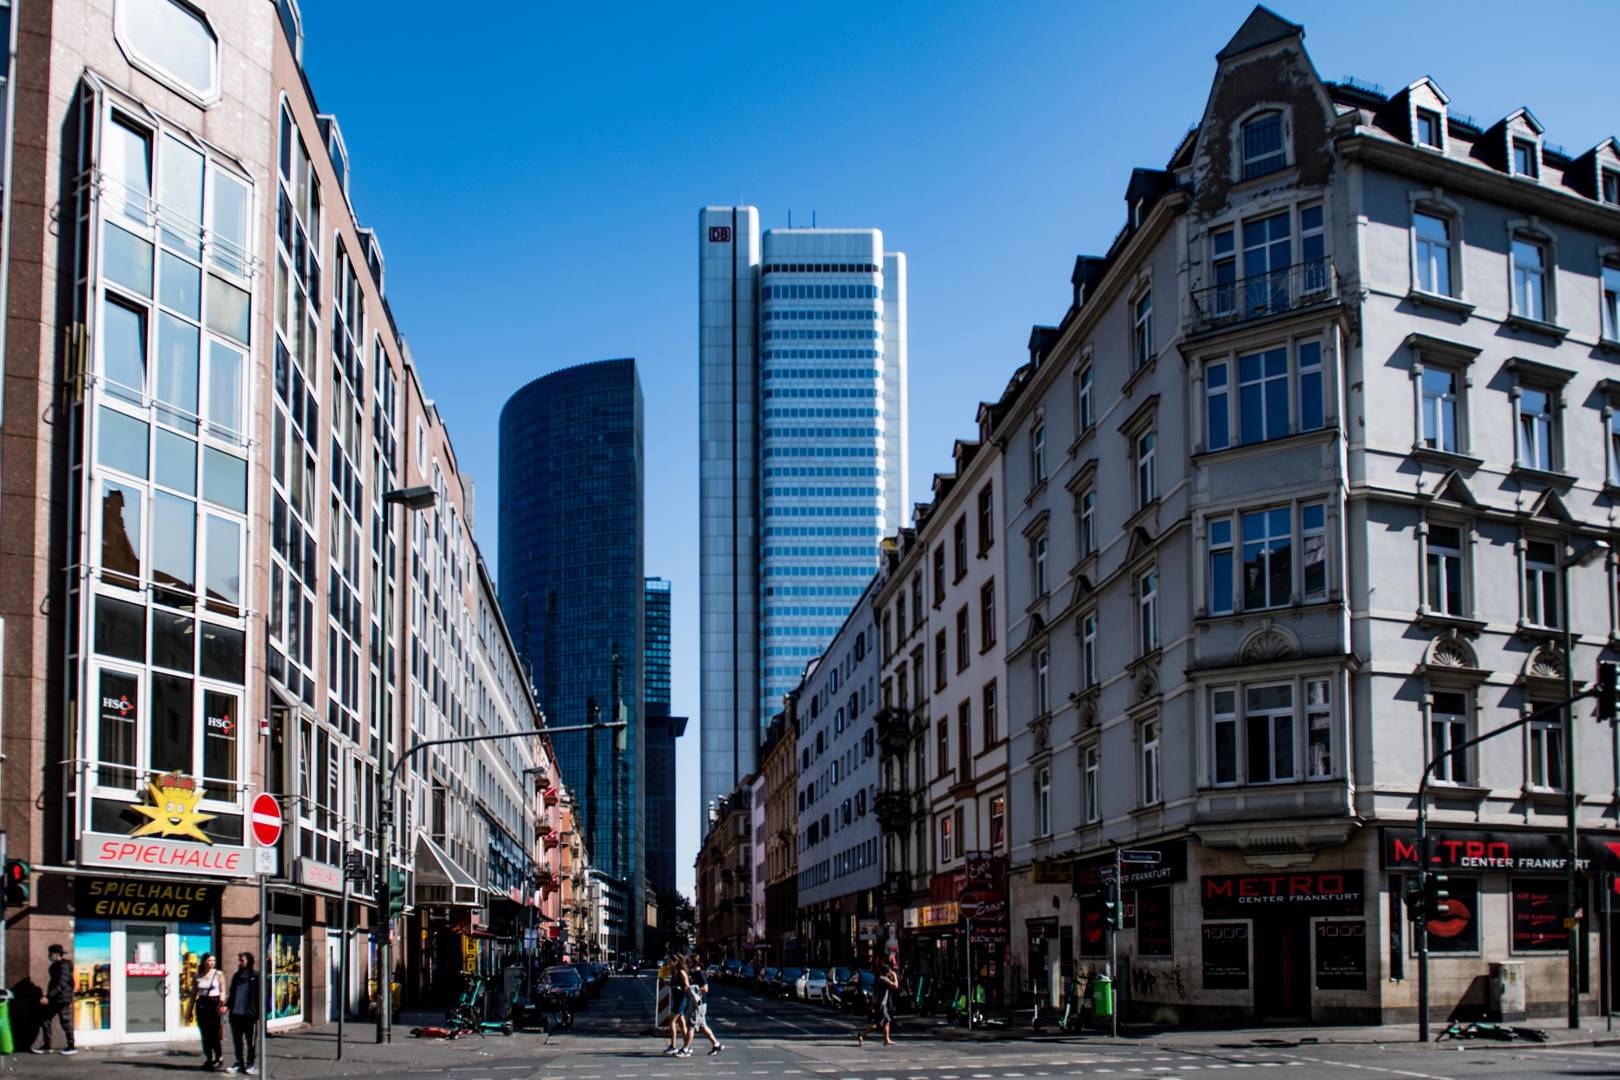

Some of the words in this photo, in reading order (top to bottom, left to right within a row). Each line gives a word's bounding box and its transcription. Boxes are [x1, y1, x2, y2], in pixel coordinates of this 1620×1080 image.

[711, 228, 729, 241] DB
[102, 698, 129, 711] HSC
[207, 717, 231, 729] HSC
[98, 842, 241, 870] SPIELHALLE
[1460, 856, 1514, 867] CENTER
[1518, 858, 1592, 869] FRANKFRT
[1131, 867, 1172, 882] FRANKFURT
[89, 881, 207, 901] SPIELHALLE
[1206, 874, 1344, 898] METRO
[1238, 895, 1284, 904] CENTER
[1289, 893, 1360, 902] FRANKFURT
[95, 900, 190, 918] EINGANG
[1203, 927, 1248, 939] 1000
[1318, 925, 1365, 937] 1000
